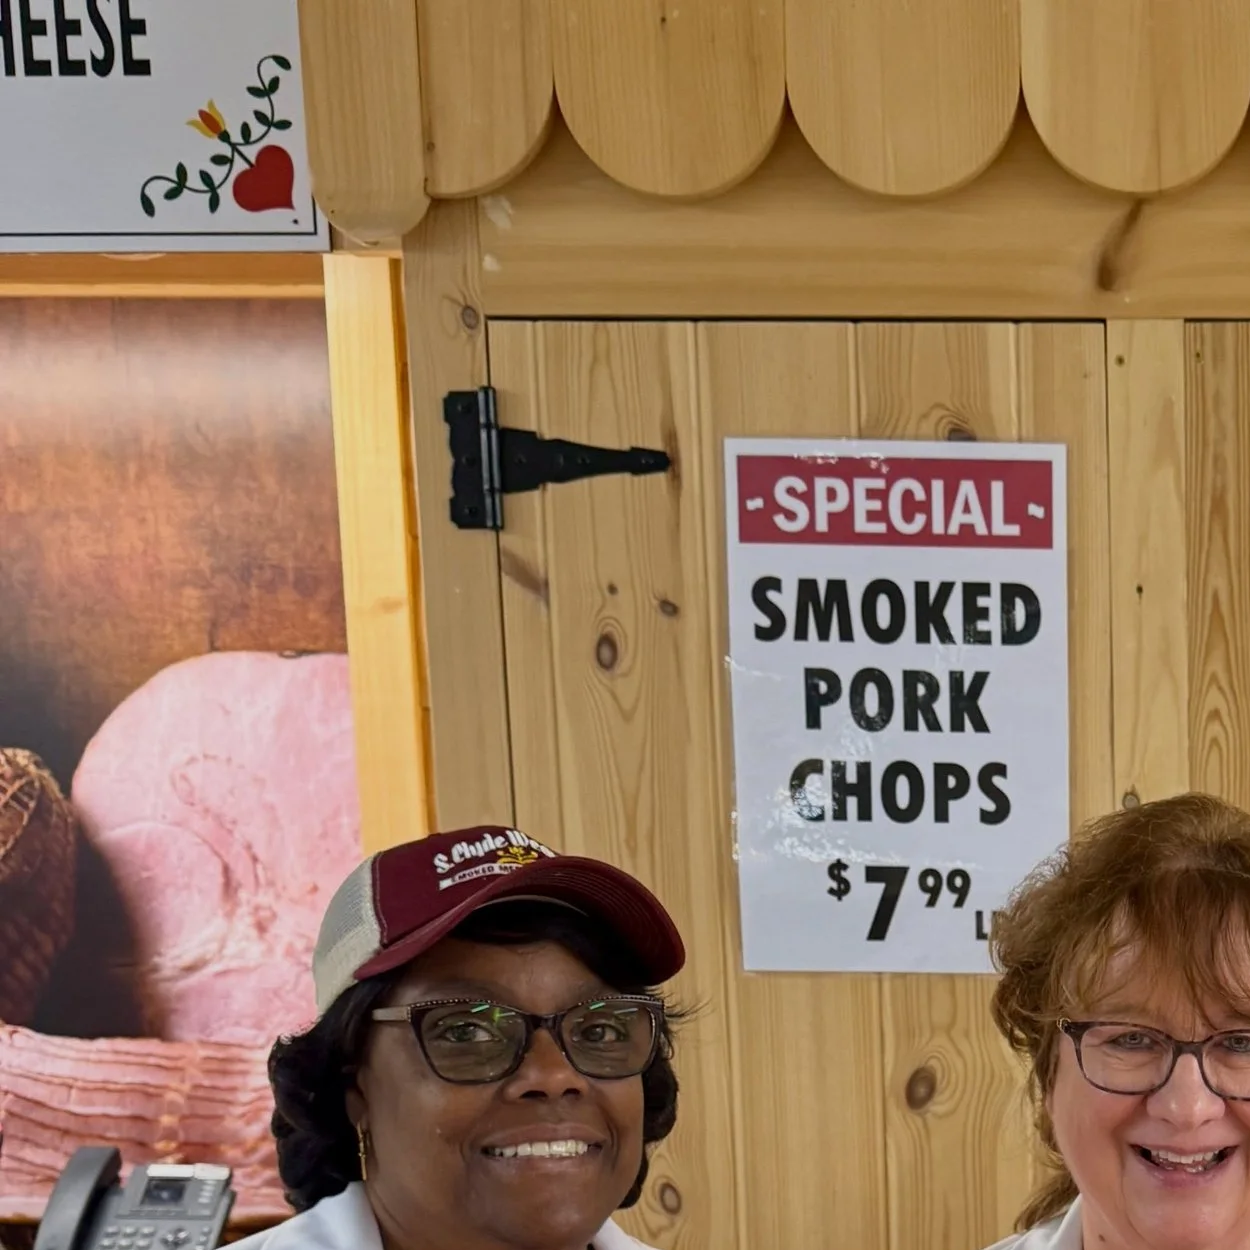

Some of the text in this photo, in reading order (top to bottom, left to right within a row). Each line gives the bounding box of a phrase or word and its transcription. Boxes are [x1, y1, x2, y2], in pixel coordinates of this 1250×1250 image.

[750, 575, 1042, 647] SMOKED
[803, 666, 991, 733] PORK
[788, 757, 1012, 825] CHOPS
